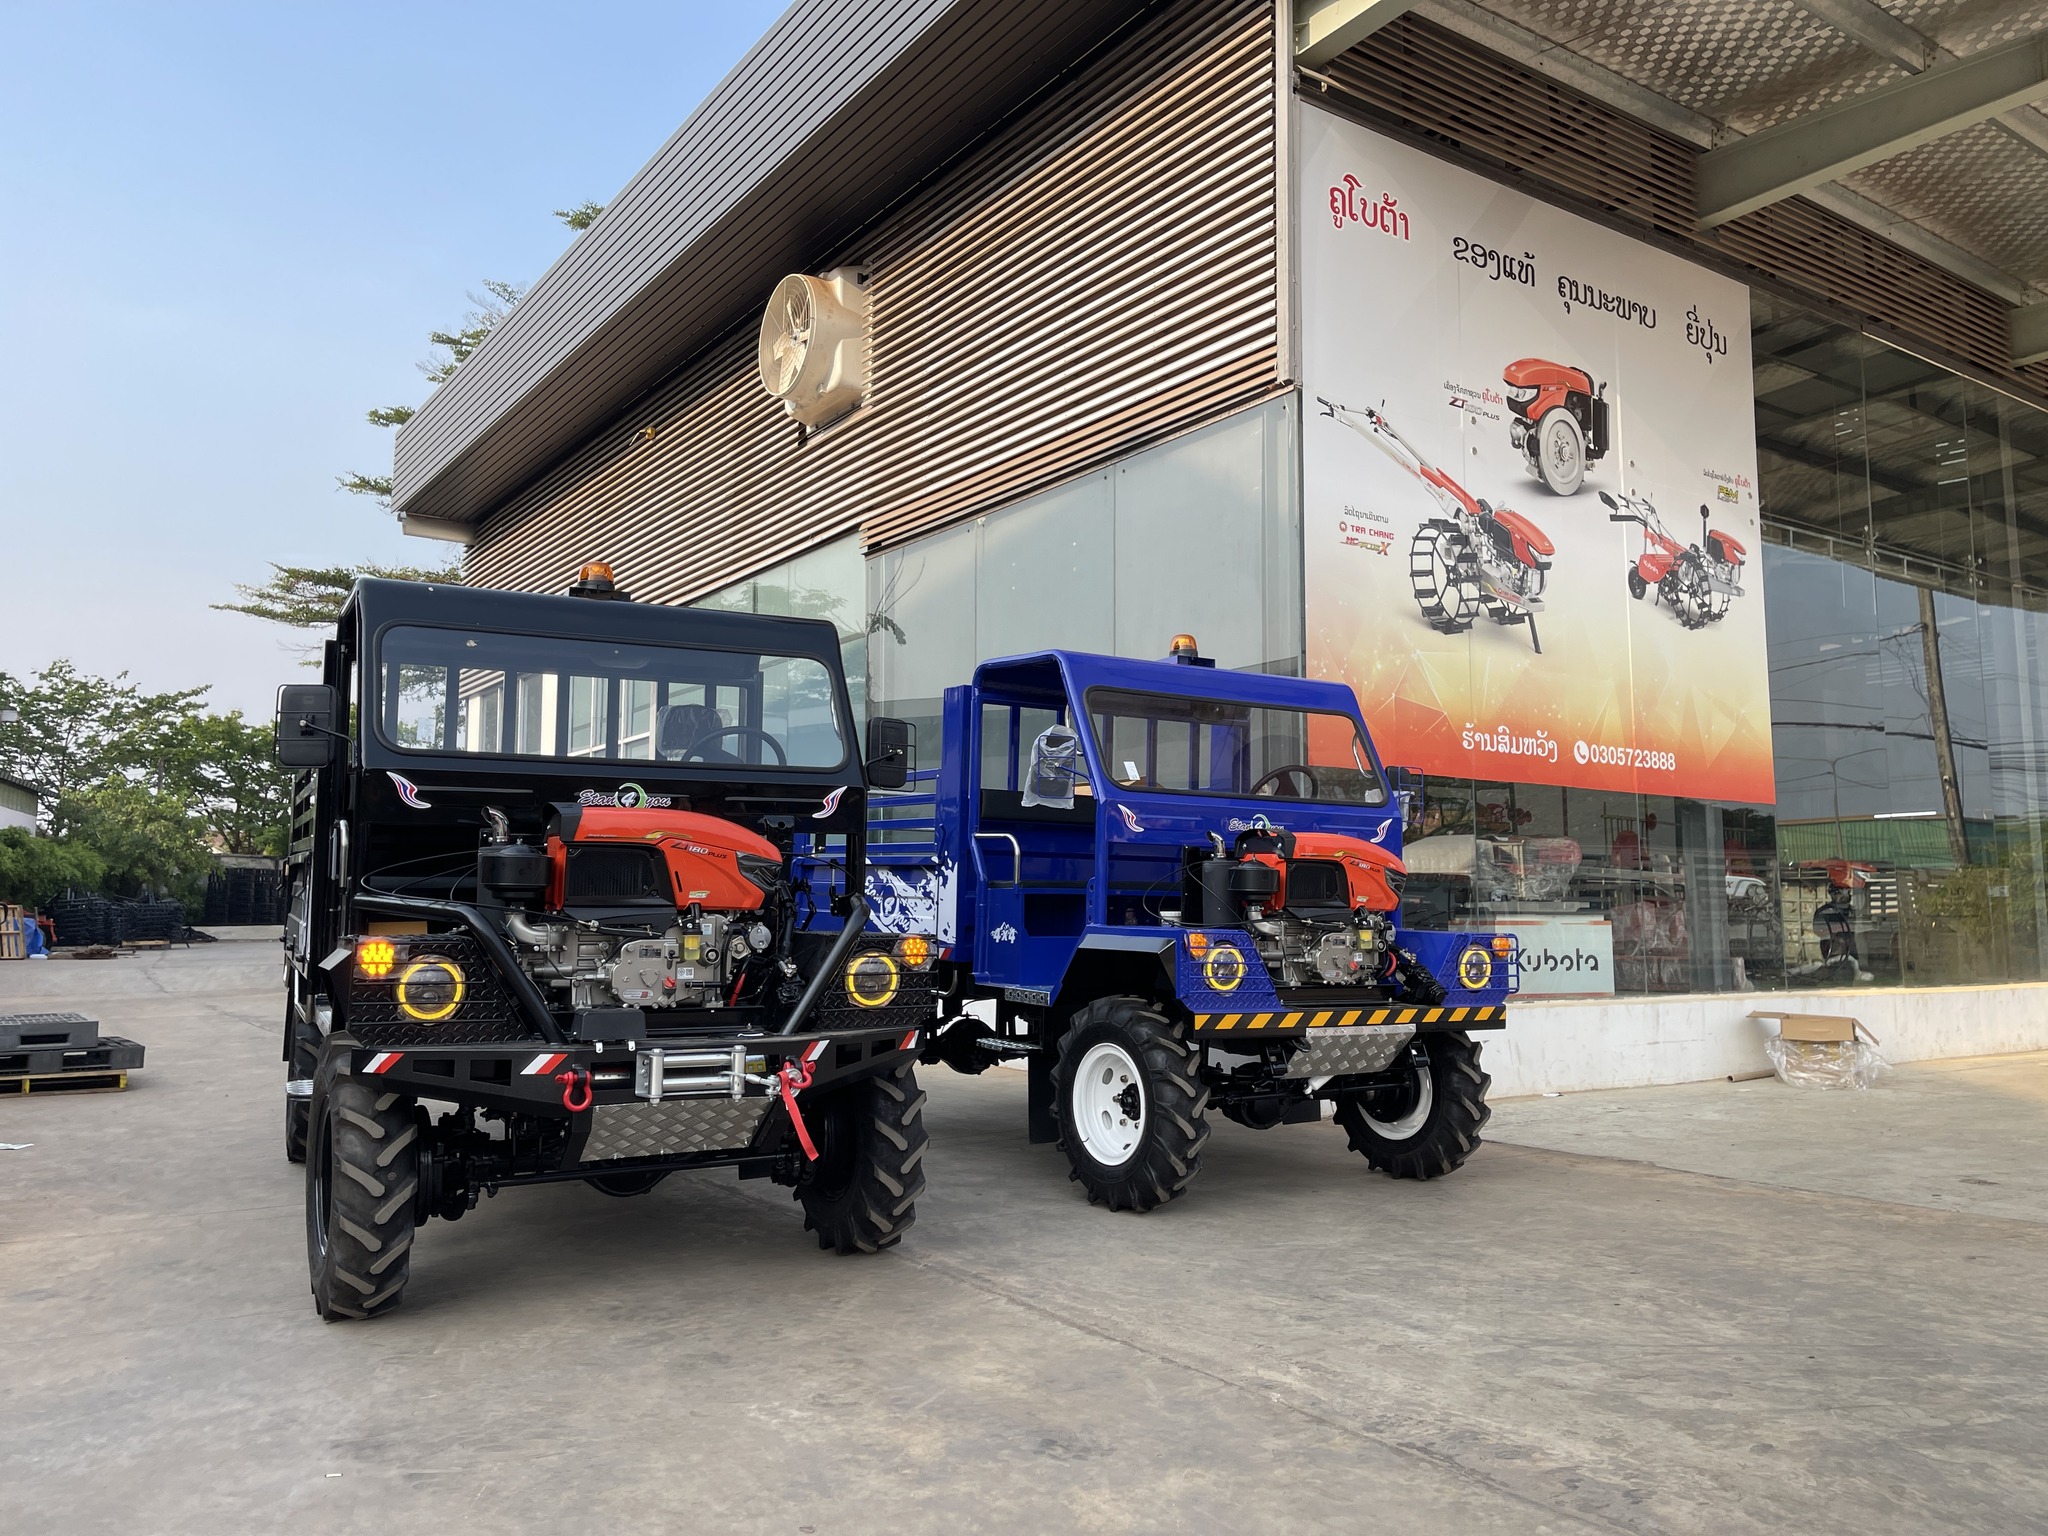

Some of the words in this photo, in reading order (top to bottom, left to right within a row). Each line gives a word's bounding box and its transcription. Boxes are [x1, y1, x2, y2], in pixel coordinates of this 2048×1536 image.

[1329, 173, 1410, 241] ຄູໂບຕ້າ
[1453, 236, 1536, 288] ຂອງແທ້
[1557, 275, 1657, 329] ຄຸນນະພາບ
[1686, 304, 1728, 365] ຍີ່ປຸ່ນ
[1482, 411, 1500, 421] PLUS
[1350, 524, 1367, 535] TRA
[1368, 528, 1395, 541] CHANG
[1461, 722, 1559, 763] ຮ້ານສົມຫວັງ
[1589, 743, 1677, 772] 0305723888
[621, 791, 638, 808] 4
[707, 851, 728, 860] PLUS
[1509, 948, 1599, 972] Kubota
